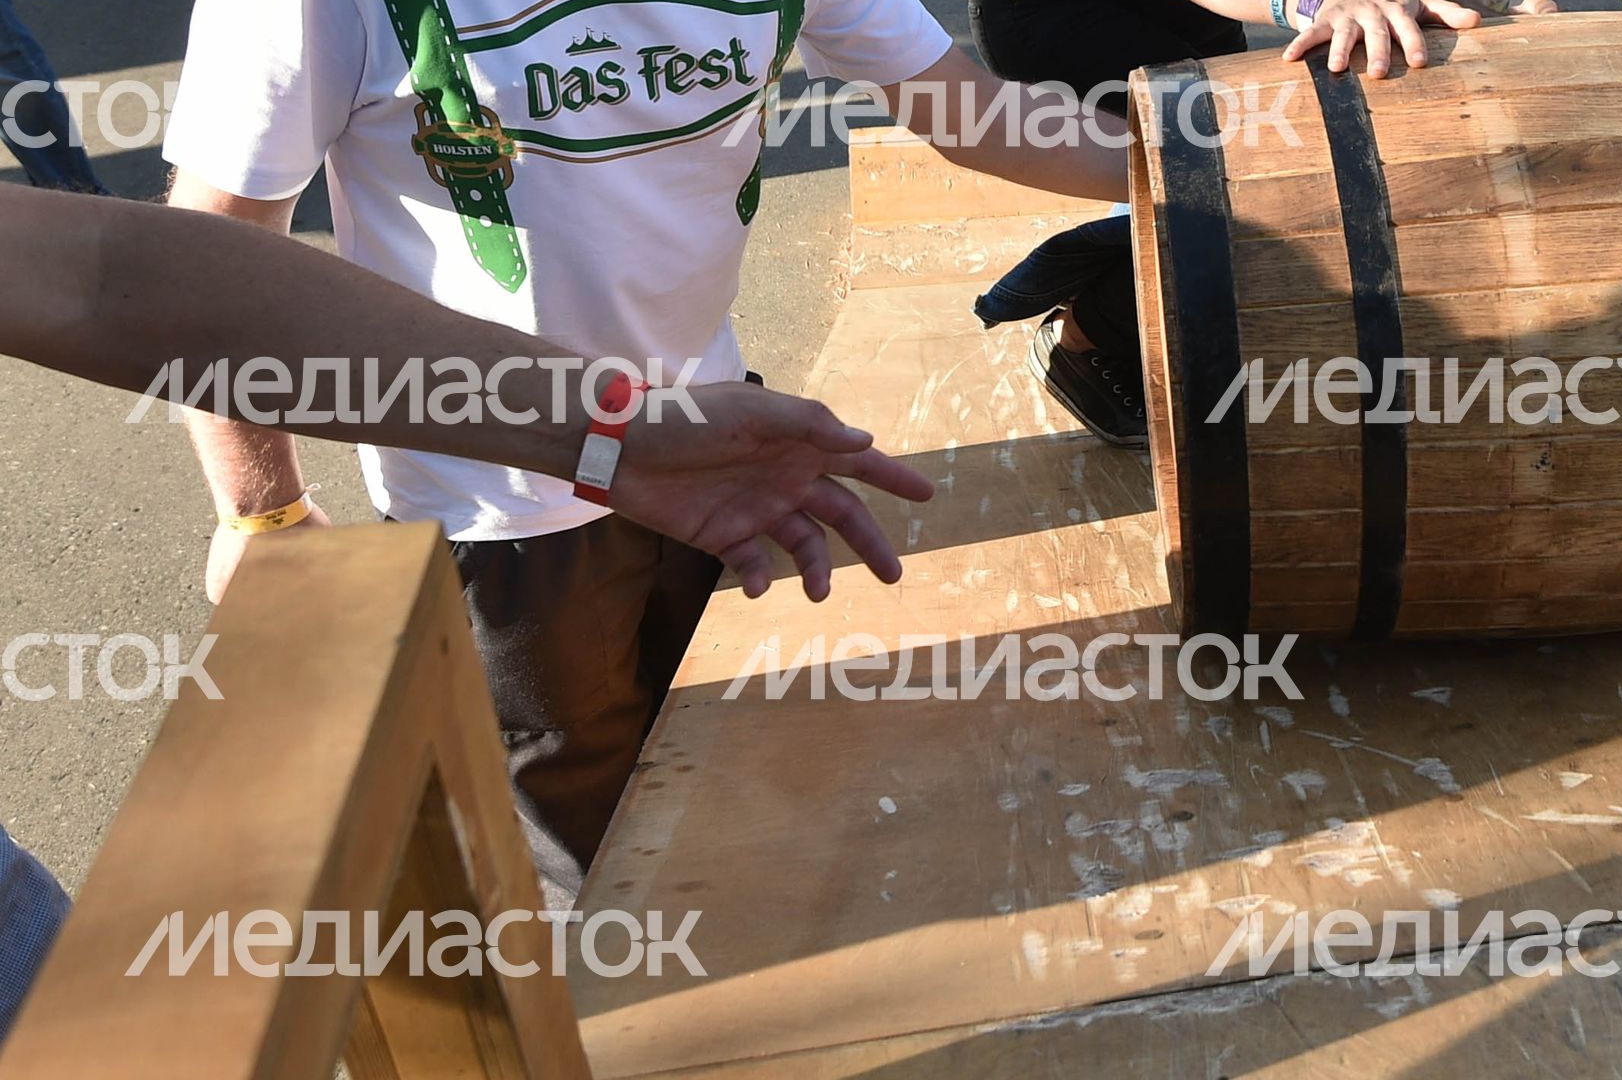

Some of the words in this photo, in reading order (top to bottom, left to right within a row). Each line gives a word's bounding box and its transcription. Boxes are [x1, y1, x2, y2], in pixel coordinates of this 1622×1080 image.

[525, 61, 631, 120] Das
[636, 37, 756, 103] Fest
[433, 144, 492, 156] HOLSTEN
